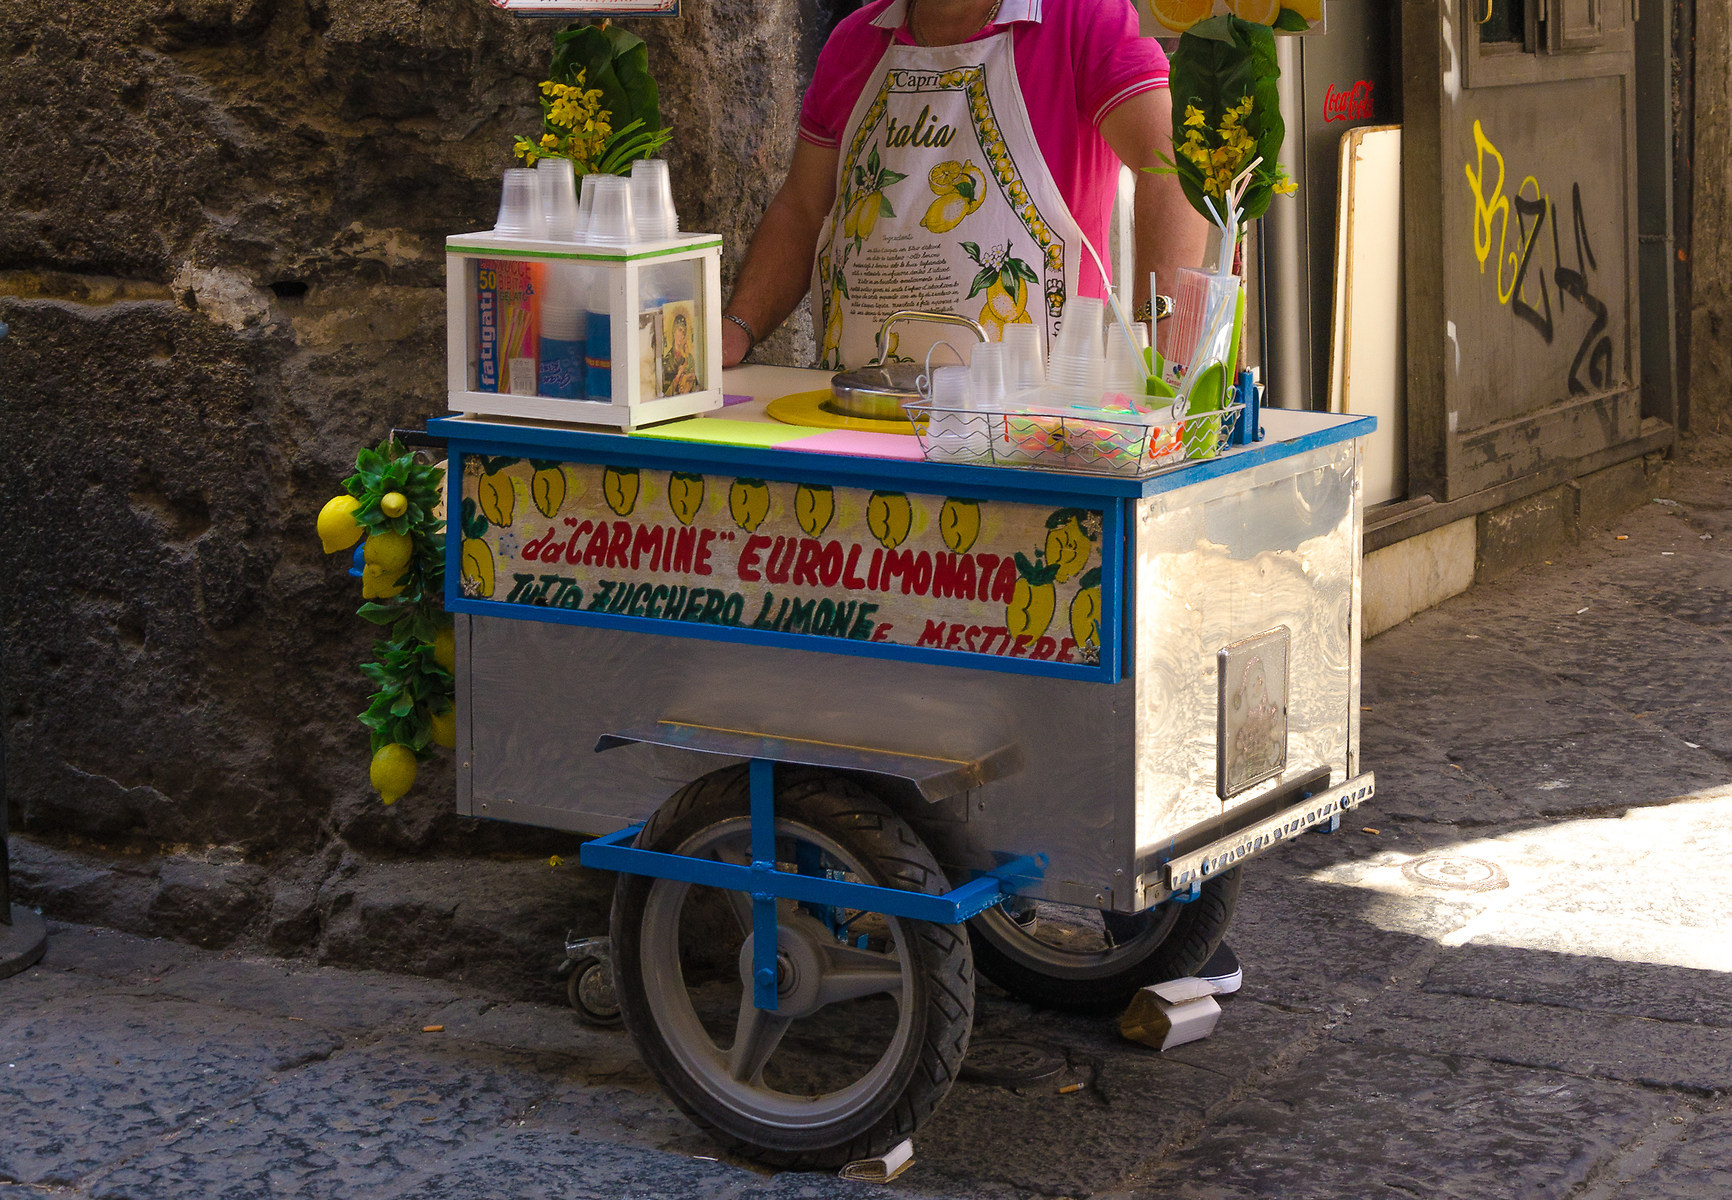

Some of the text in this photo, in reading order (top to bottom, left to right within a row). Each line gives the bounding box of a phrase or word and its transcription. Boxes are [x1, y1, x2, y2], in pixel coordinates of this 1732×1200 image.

[895, 71, 939, 91] Capri
[480, 270, 497, 290] 50
[478, 291, 496, 386] fatigati
[737, 534, 1017, 605] EUROLIMONATA
[506, 572, 584, 609] TUTTO
[588, 579, 746, 628] ZUCCHERO
[751, 591, 879, 642] LIMONE
